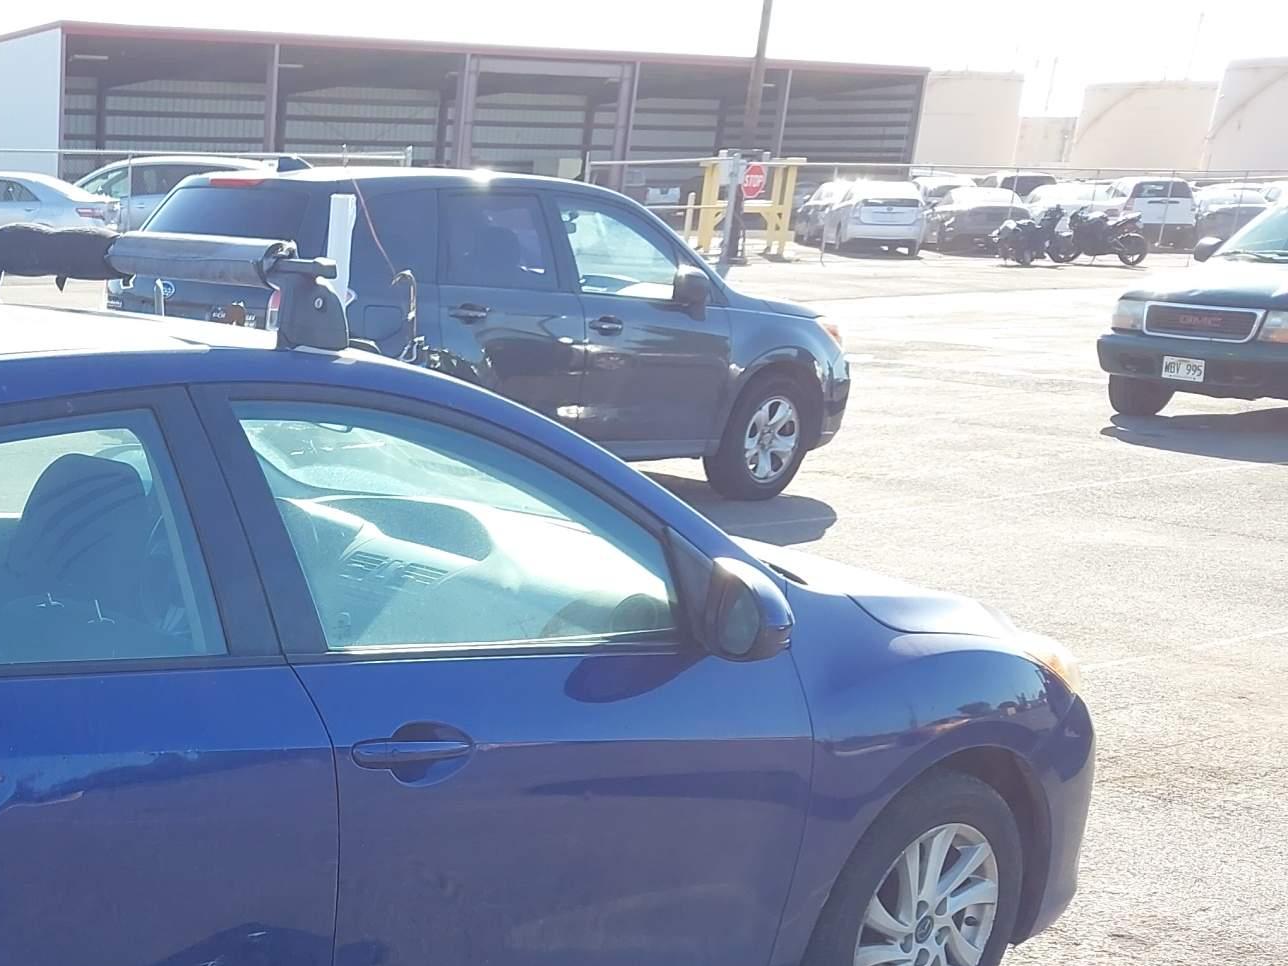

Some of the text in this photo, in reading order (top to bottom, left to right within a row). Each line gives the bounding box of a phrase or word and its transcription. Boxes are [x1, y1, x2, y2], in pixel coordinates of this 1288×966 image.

[743, 174, 763, 188] STOP
[1179, 314, 1223, 327] GMC
[1186, 363, 1202, 376] 995
